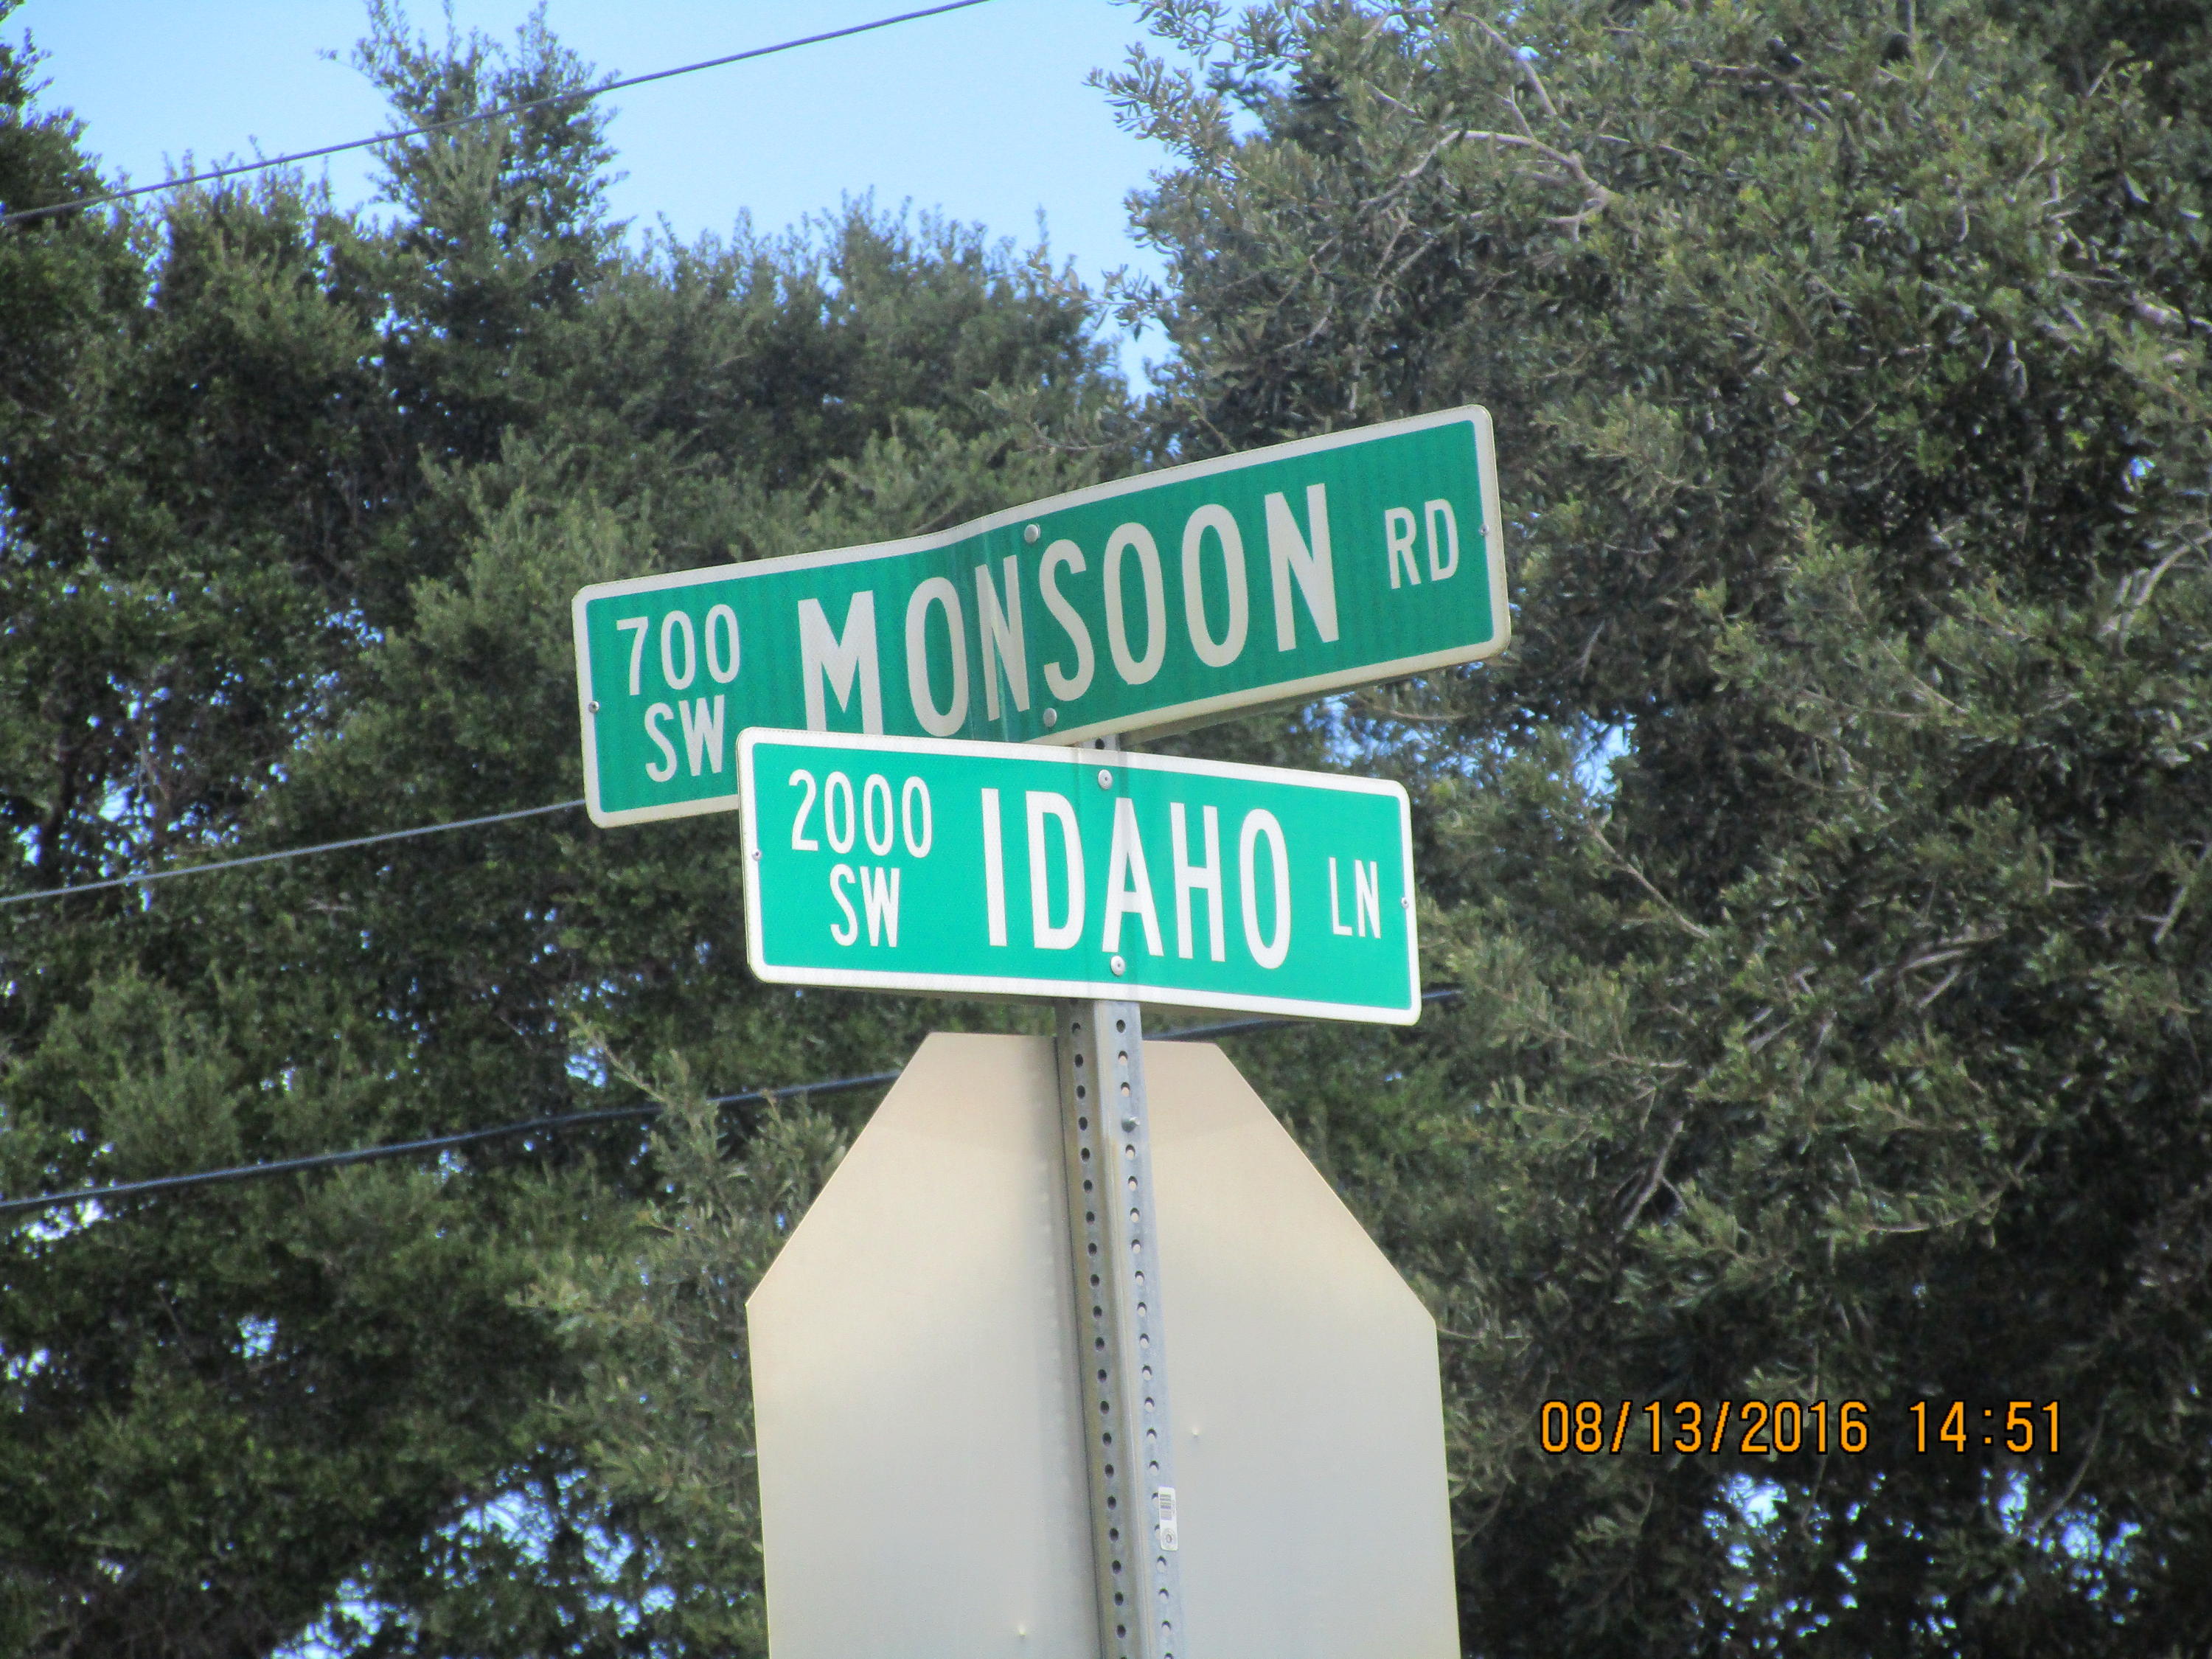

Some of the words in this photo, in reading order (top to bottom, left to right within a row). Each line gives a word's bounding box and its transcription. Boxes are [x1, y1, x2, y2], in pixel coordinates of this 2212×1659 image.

[616, 603, 740, 696] 700
[798, 482, 1340, 737] MONSOON
[1384, 498, 1459, 590] RD
[644, 694, 726, 783] SW
[789, 768, 934, 859] 2000
[981, 787, 1292, 970] IDAHO
[1329, 856, 1382, 939] LN
[830, 863, 901, 947] SW
